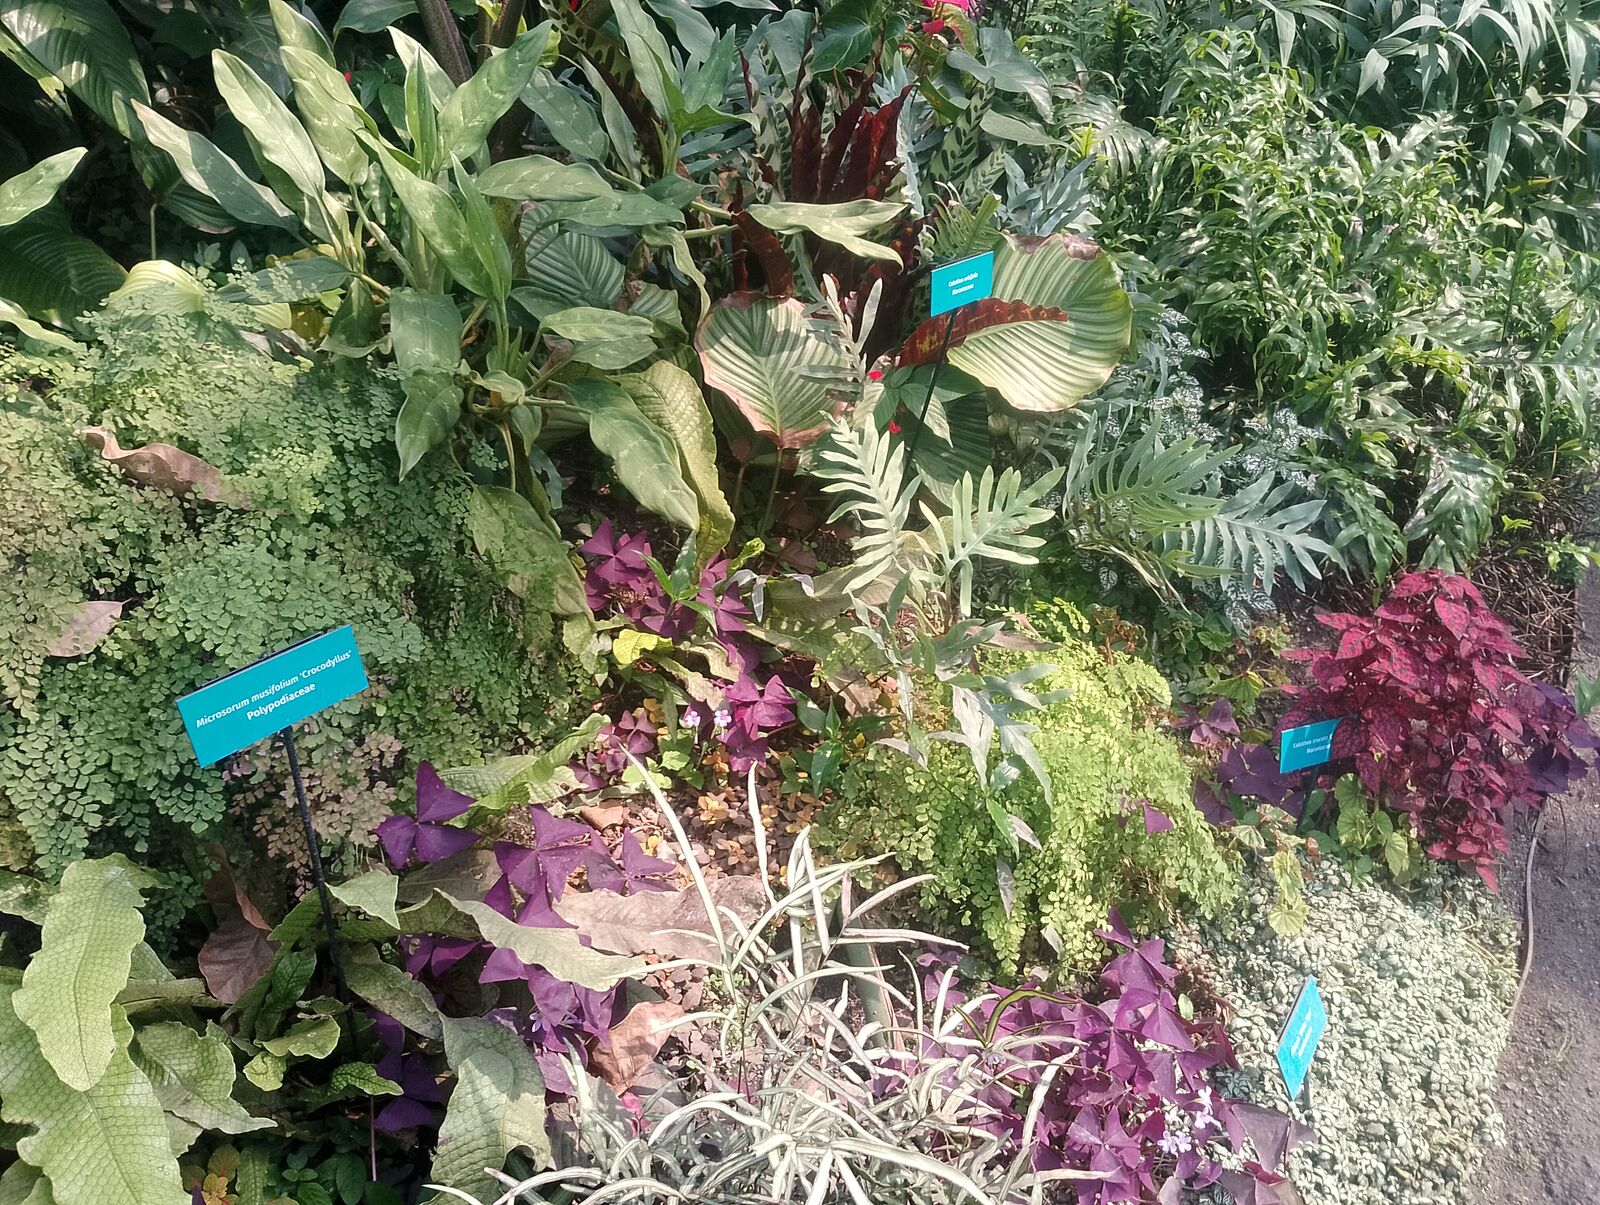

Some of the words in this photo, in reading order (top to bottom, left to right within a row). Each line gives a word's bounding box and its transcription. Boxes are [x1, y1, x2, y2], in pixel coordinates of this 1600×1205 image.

[196, 698, 250, 728] Microsorum
[251, 675, 299, 703] musifolium
[299, 649, 352, 679] 'Crocodyllus'
[246, 682, 316, 721] Polypodiaceae
